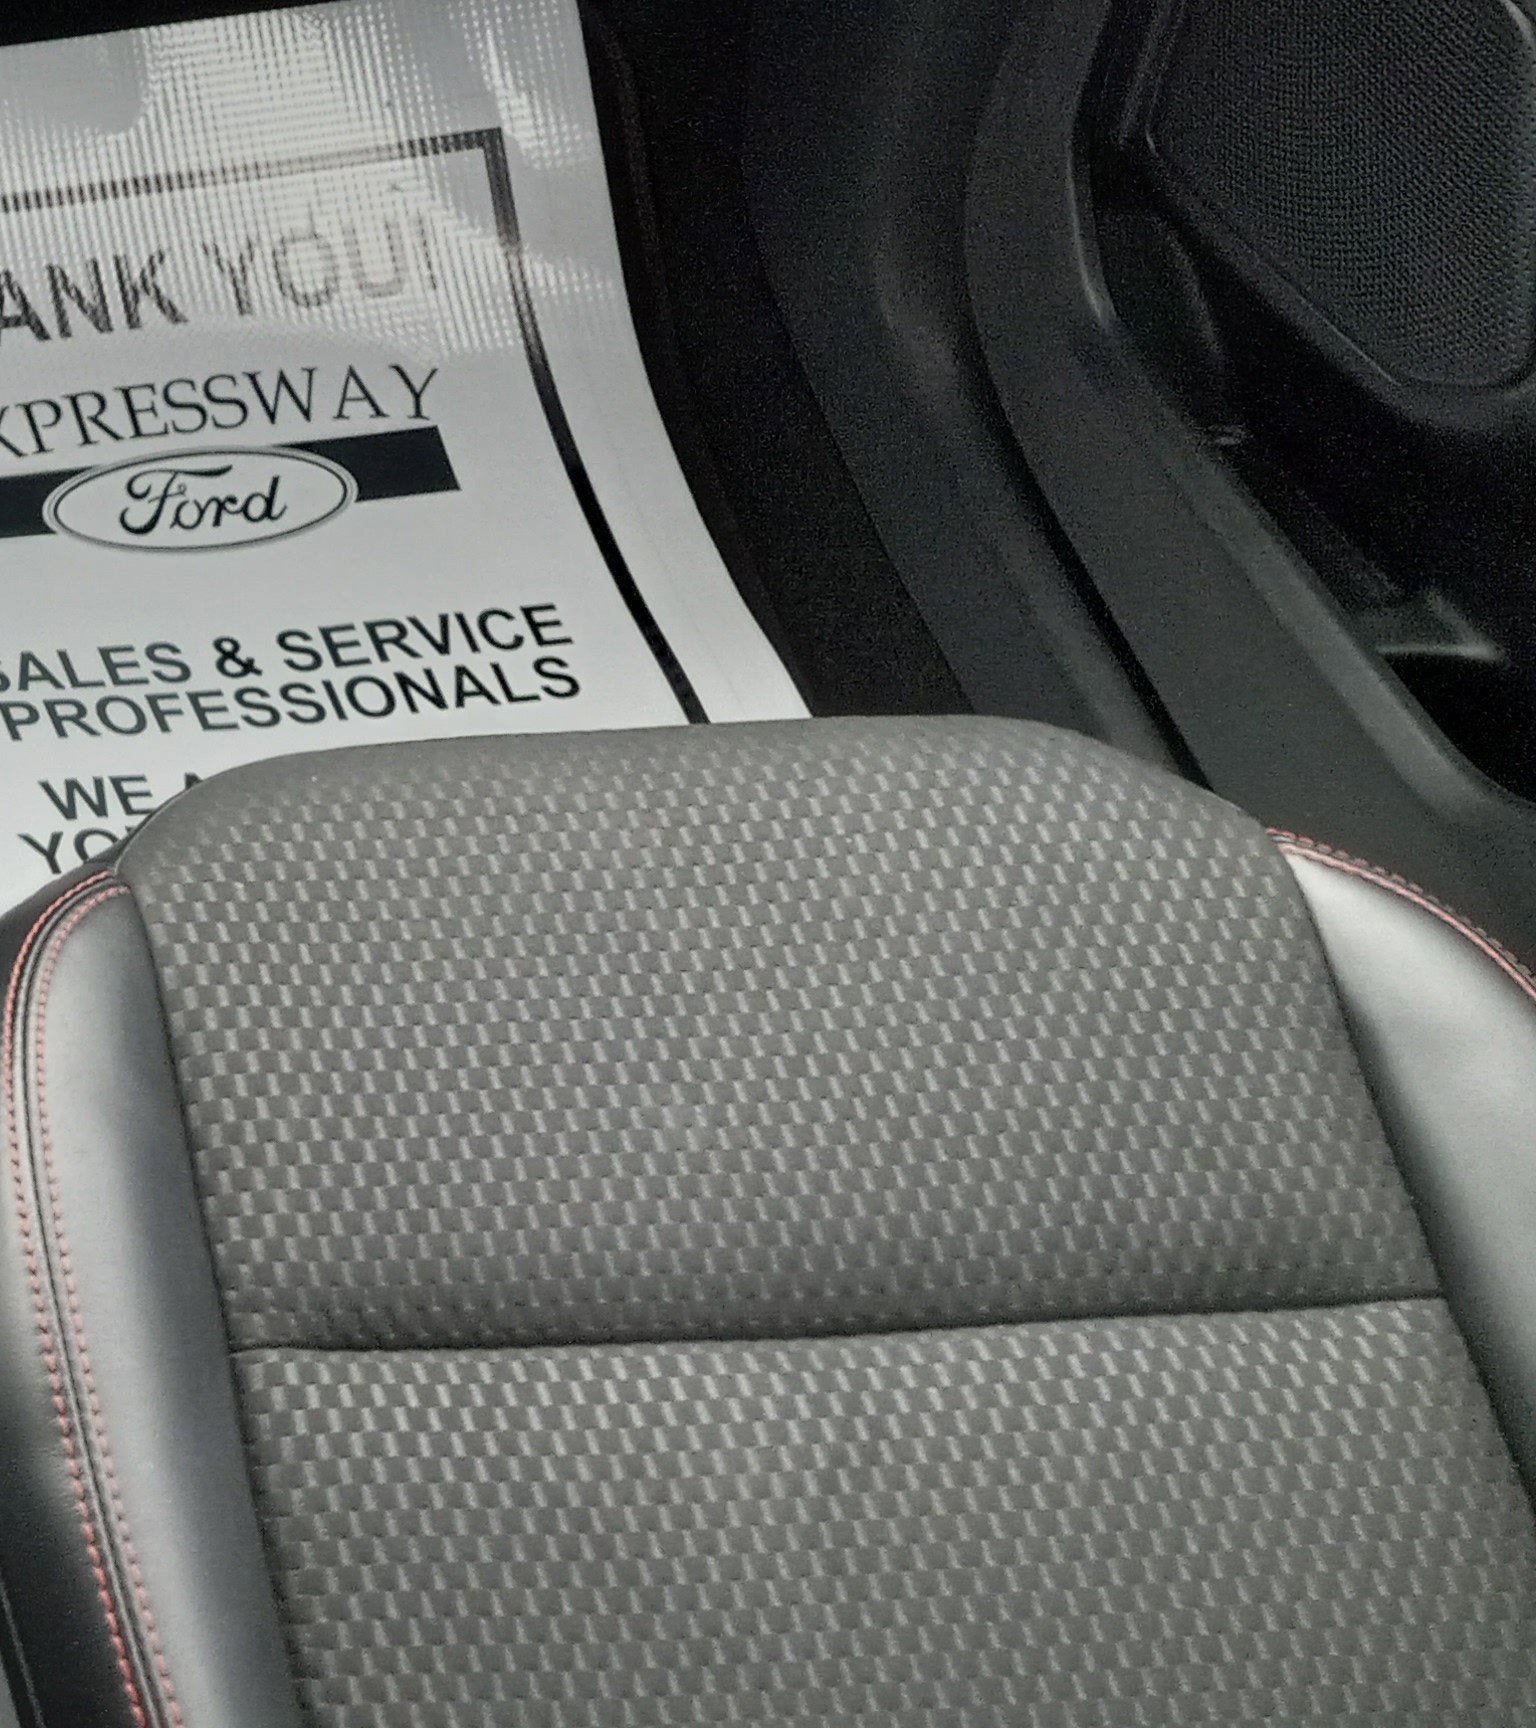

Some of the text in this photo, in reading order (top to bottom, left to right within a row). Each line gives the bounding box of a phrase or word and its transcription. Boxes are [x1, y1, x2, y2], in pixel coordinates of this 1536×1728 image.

[118, 464, 288, 537] Ford
[212, 636, 262, 679] &
[274, 603, 575, 673] SERVICE
[37, 772, 156, 821] WE
